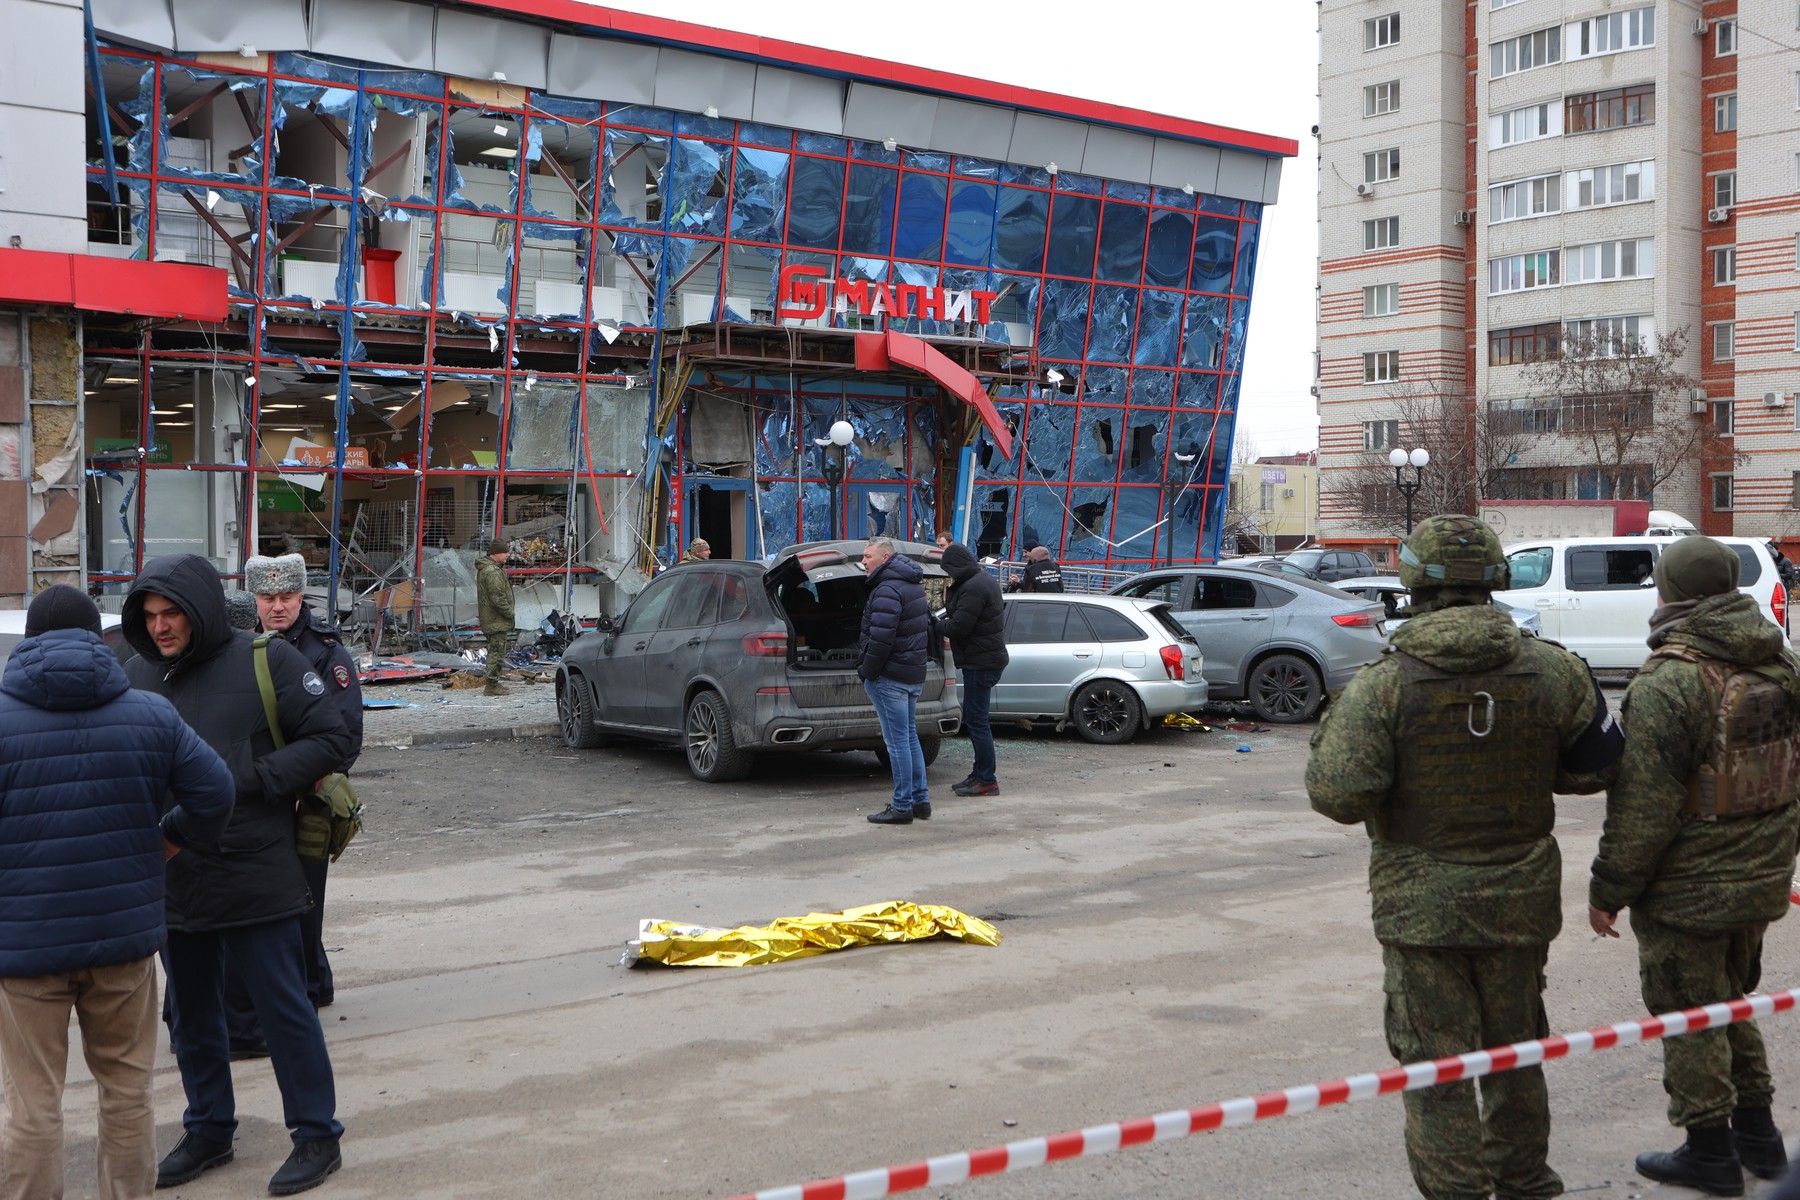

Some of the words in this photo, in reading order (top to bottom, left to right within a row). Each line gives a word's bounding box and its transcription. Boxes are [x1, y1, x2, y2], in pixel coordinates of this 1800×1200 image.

[836, 277, 996, 324] МАГНИТ
[326, 450, 364, 459] ДЕСКИЕ
[1262, 470, 1286, 480] ЦВЕТЫ
